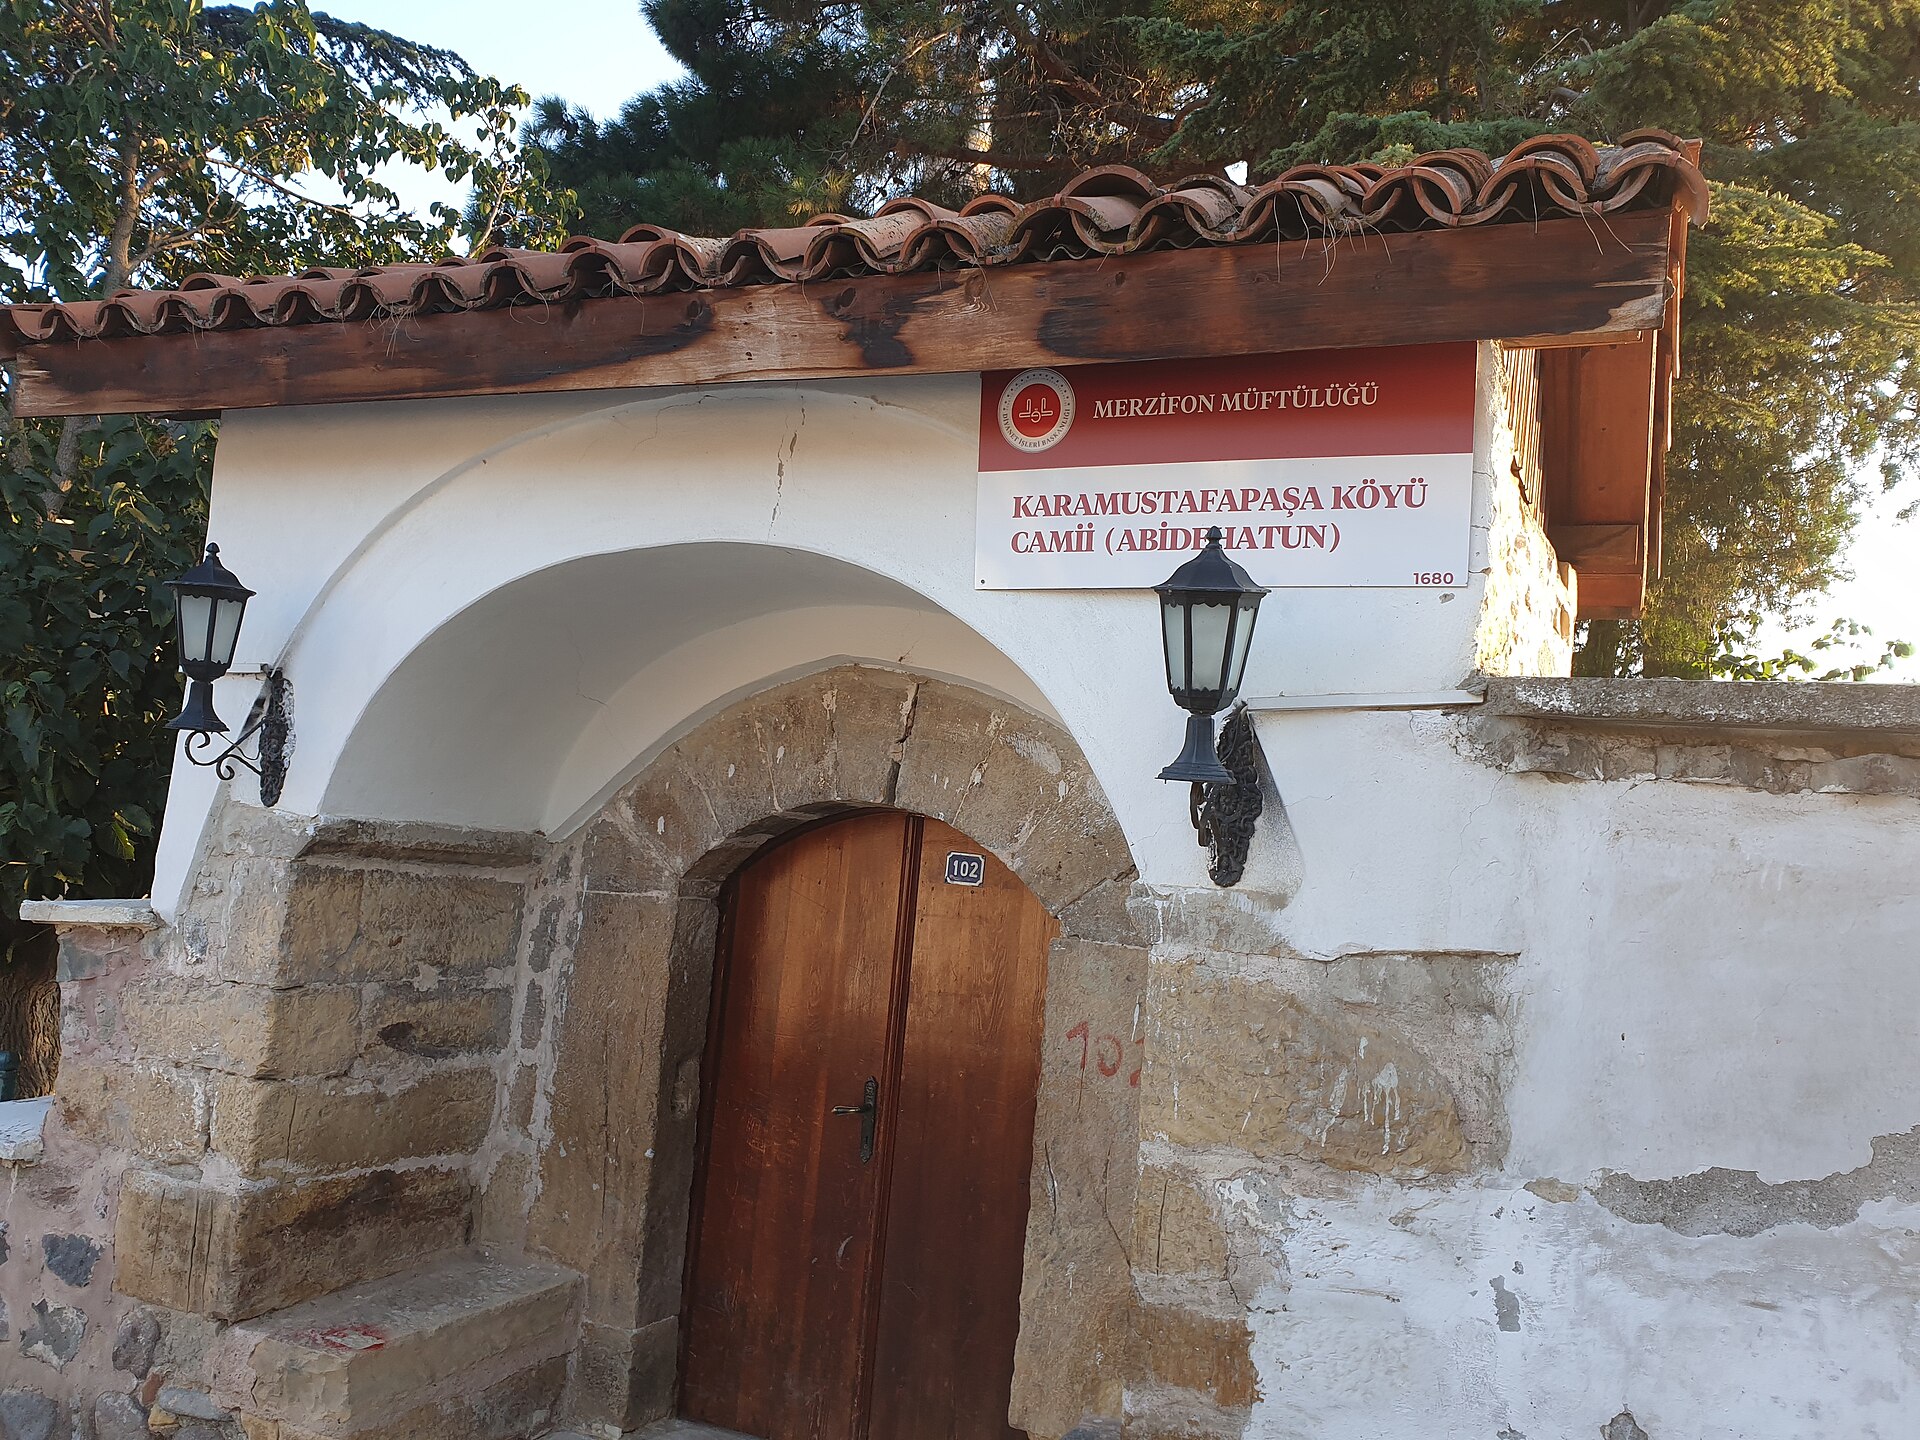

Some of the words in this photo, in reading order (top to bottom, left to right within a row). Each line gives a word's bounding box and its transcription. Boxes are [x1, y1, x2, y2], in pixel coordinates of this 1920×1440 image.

[1093, 391, 1215, 419] MERZİFON
[1219, 381, 1379, 412] MÜFTÜLÜĞÜ
[1012, 486, 1324, 518] KARAMUSTAFAPAŞA
[1331, 477, 1428, 510] KÖYÜ
[1010, 522, 1096, 553] CAMİİ
[1413, 572, 1454, 585] 1680
[953, 860, 979, 878] 102
